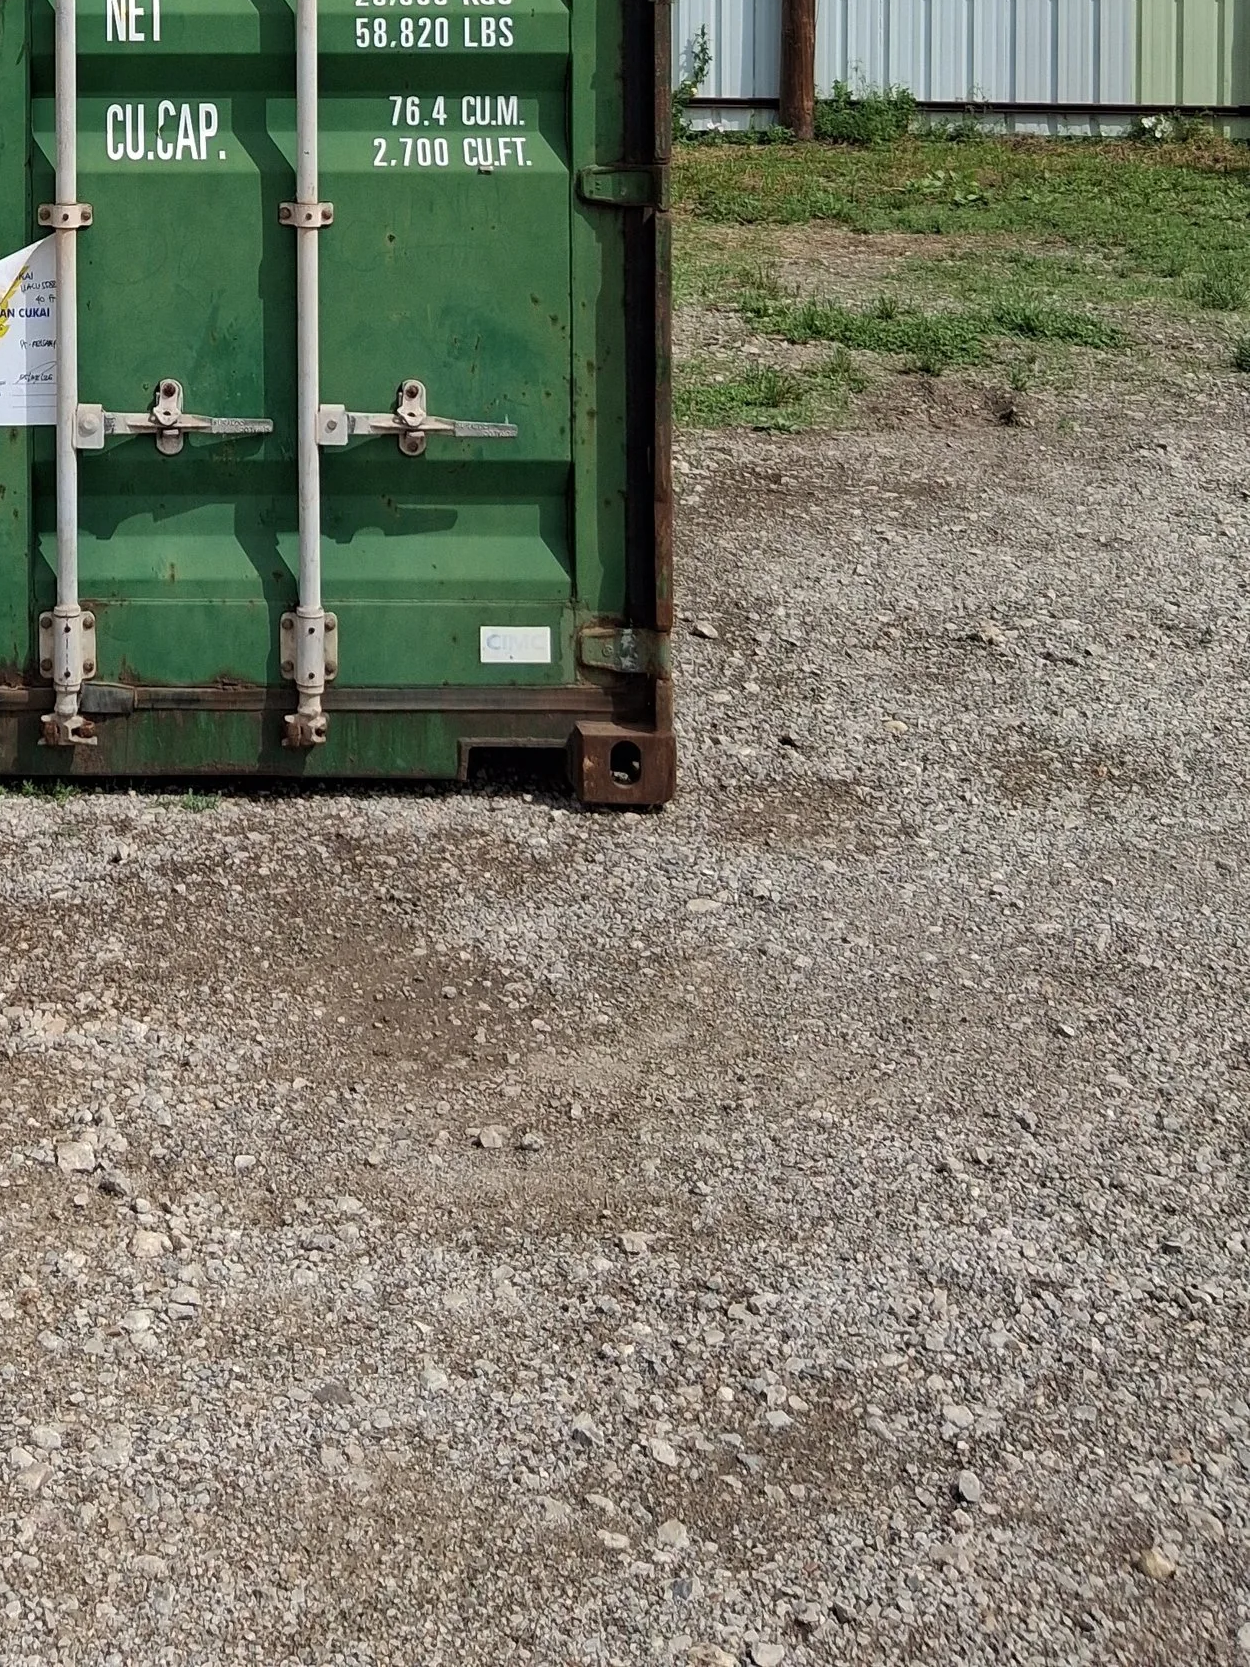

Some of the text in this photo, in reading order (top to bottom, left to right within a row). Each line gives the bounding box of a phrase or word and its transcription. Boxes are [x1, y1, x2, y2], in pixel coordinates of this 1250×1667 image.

[355, 17, 514, 48] 58,820 LBS
[388, 95, 525, 126] 76.4 CU.M.
[106, 100, 227, 161] CU.CAP.
[463, 137, 532, 167] CU.FT.
[18, 308, 50, 318] CUKAI
